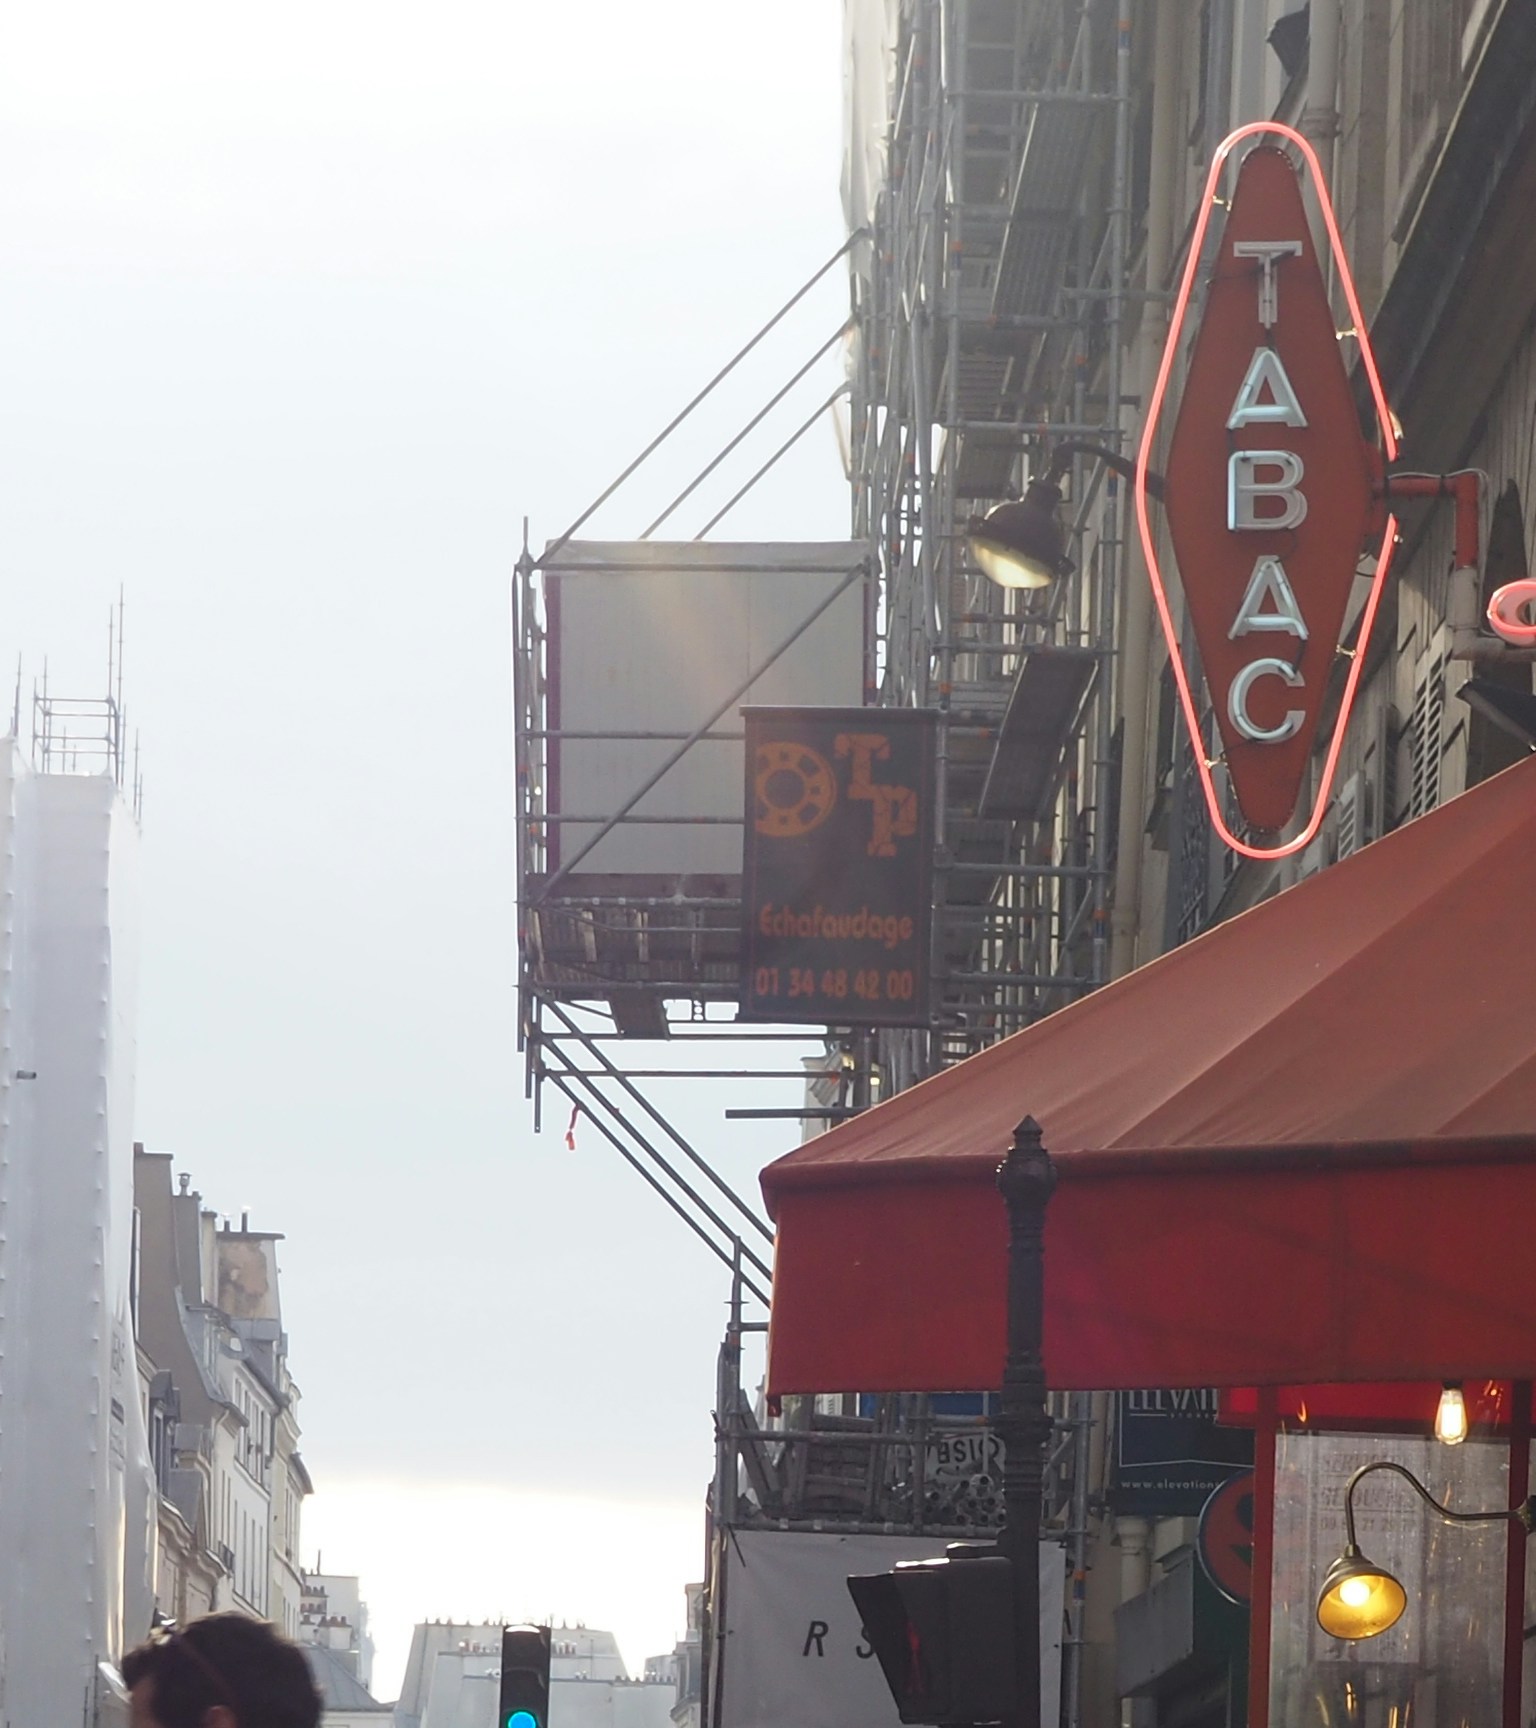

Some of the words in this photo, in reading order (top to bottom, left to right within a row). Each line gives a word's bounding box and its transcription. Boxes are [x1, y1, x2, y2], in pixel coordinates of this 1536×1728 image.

[1228, 241, 1308, 743] TABAC
[756, 968, 779, 996] 01
[788, 968, 813, 997] 34
[821, 968, 847, 997] 48
[855, 969, 880, 999] 42
[887, 969, 913, 999] 00
